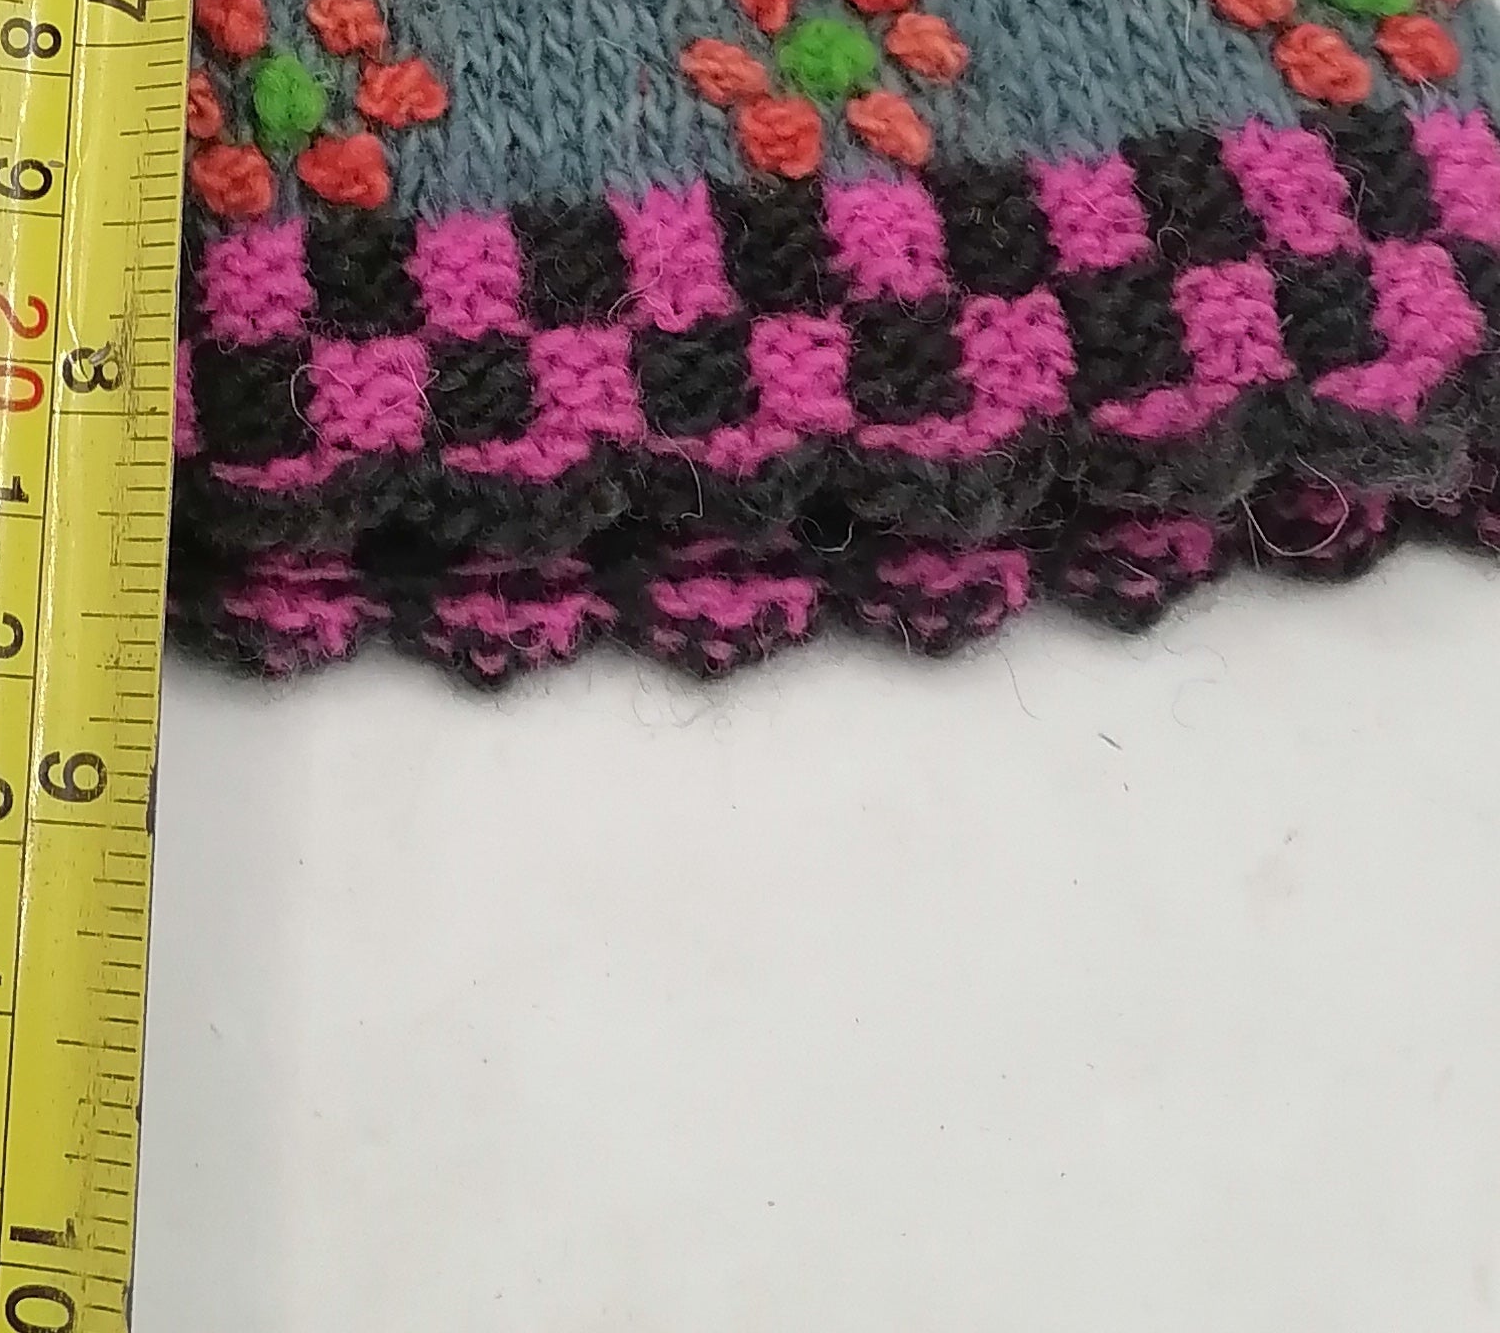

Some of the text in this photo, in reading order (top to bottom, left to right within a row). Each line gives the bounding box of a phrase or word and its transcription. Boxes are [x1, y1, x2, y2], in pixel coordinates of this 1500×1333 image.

[0, 17, 62, 59] 8
[62, 346, 123, 393] 8
[38, 751, 107, 803] 9
[5, 1217, 83, 1333] 10
